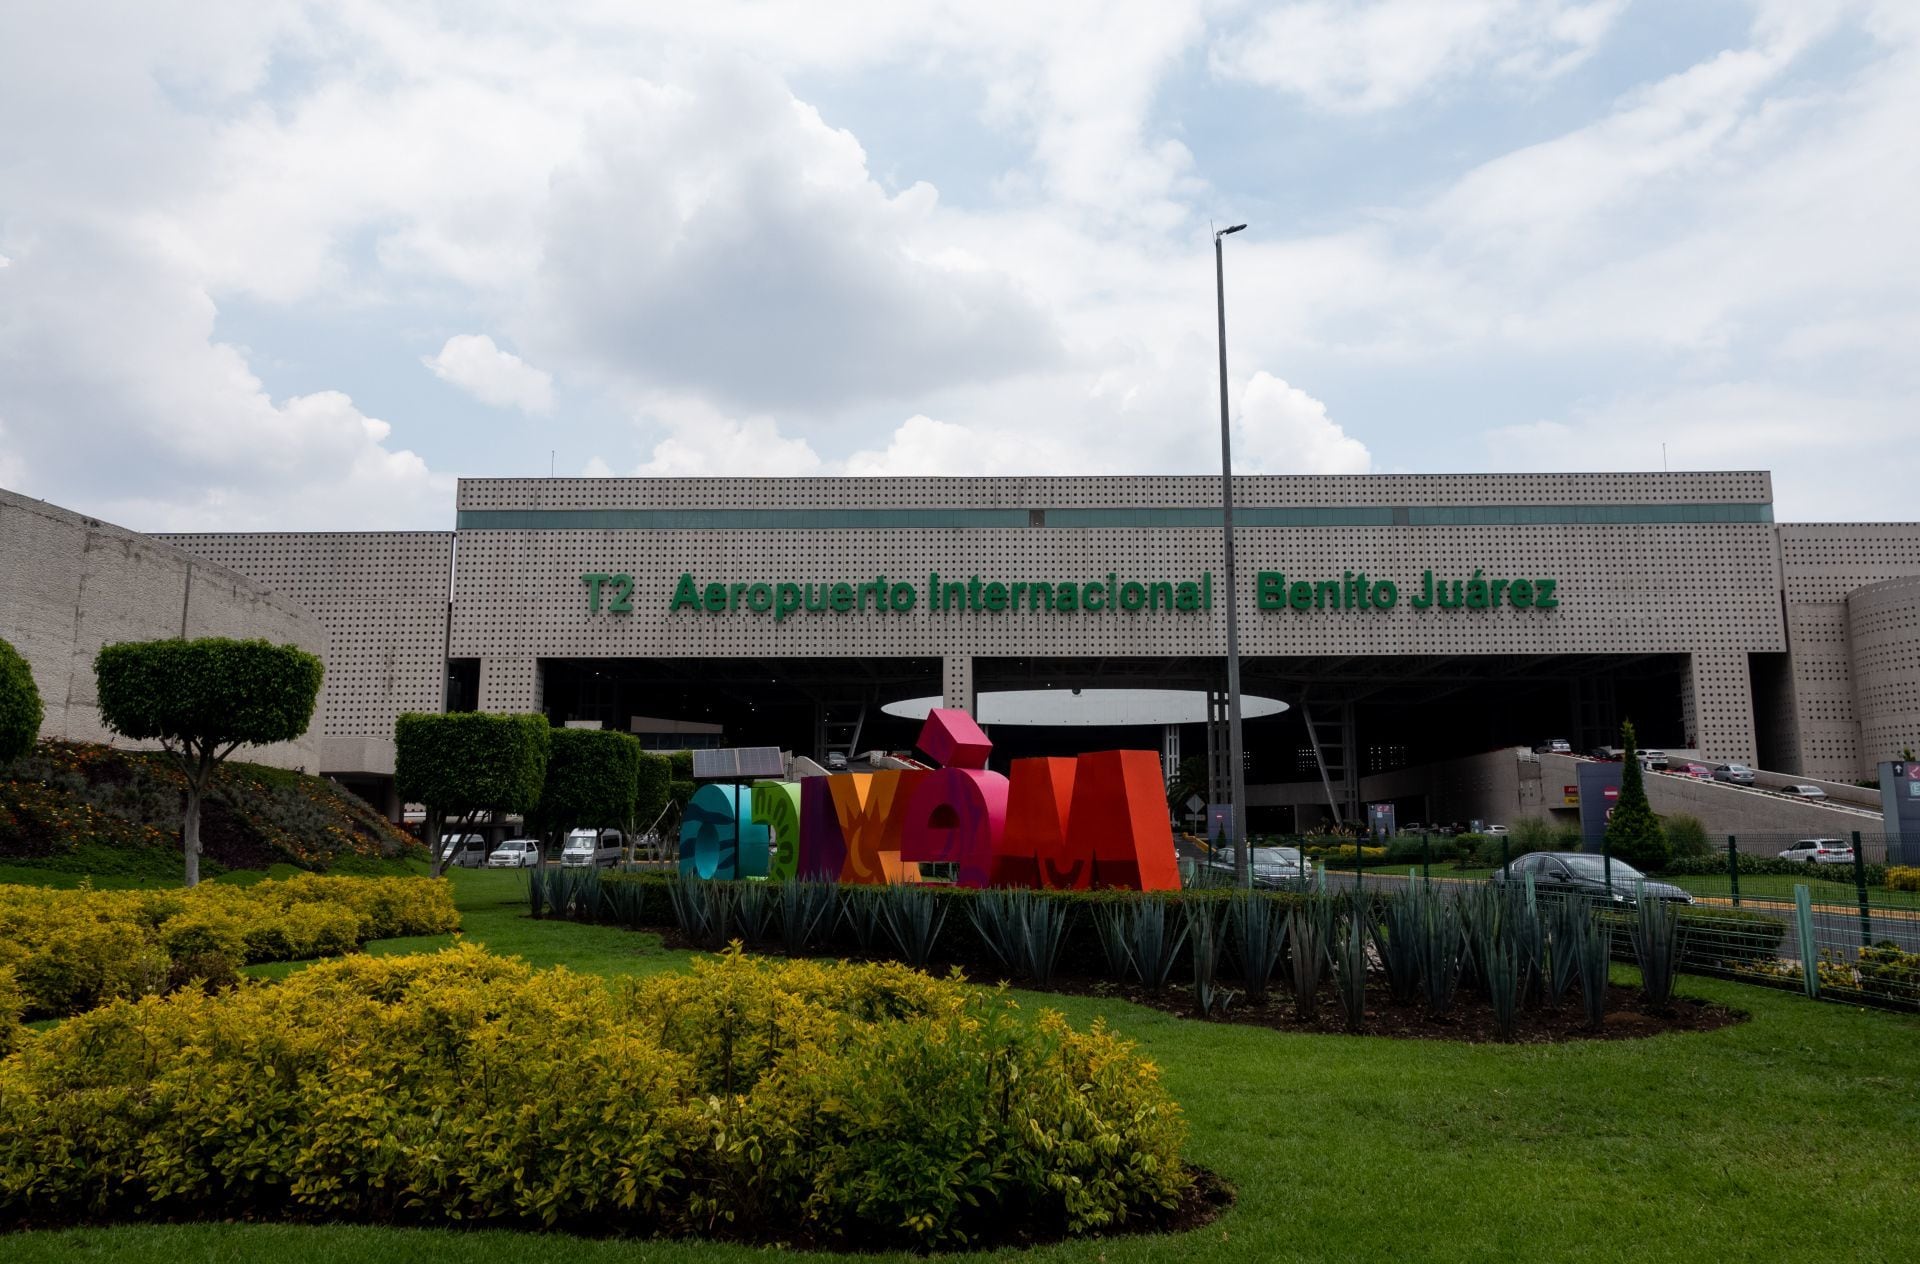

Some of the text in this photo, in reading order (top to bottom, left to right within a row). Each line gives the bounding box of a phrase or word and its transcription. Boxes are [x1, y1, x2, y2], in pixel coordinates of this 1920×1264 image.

[582, 568, 1560, 621] T2 Aeropuerto Internacional Benito Juárez
